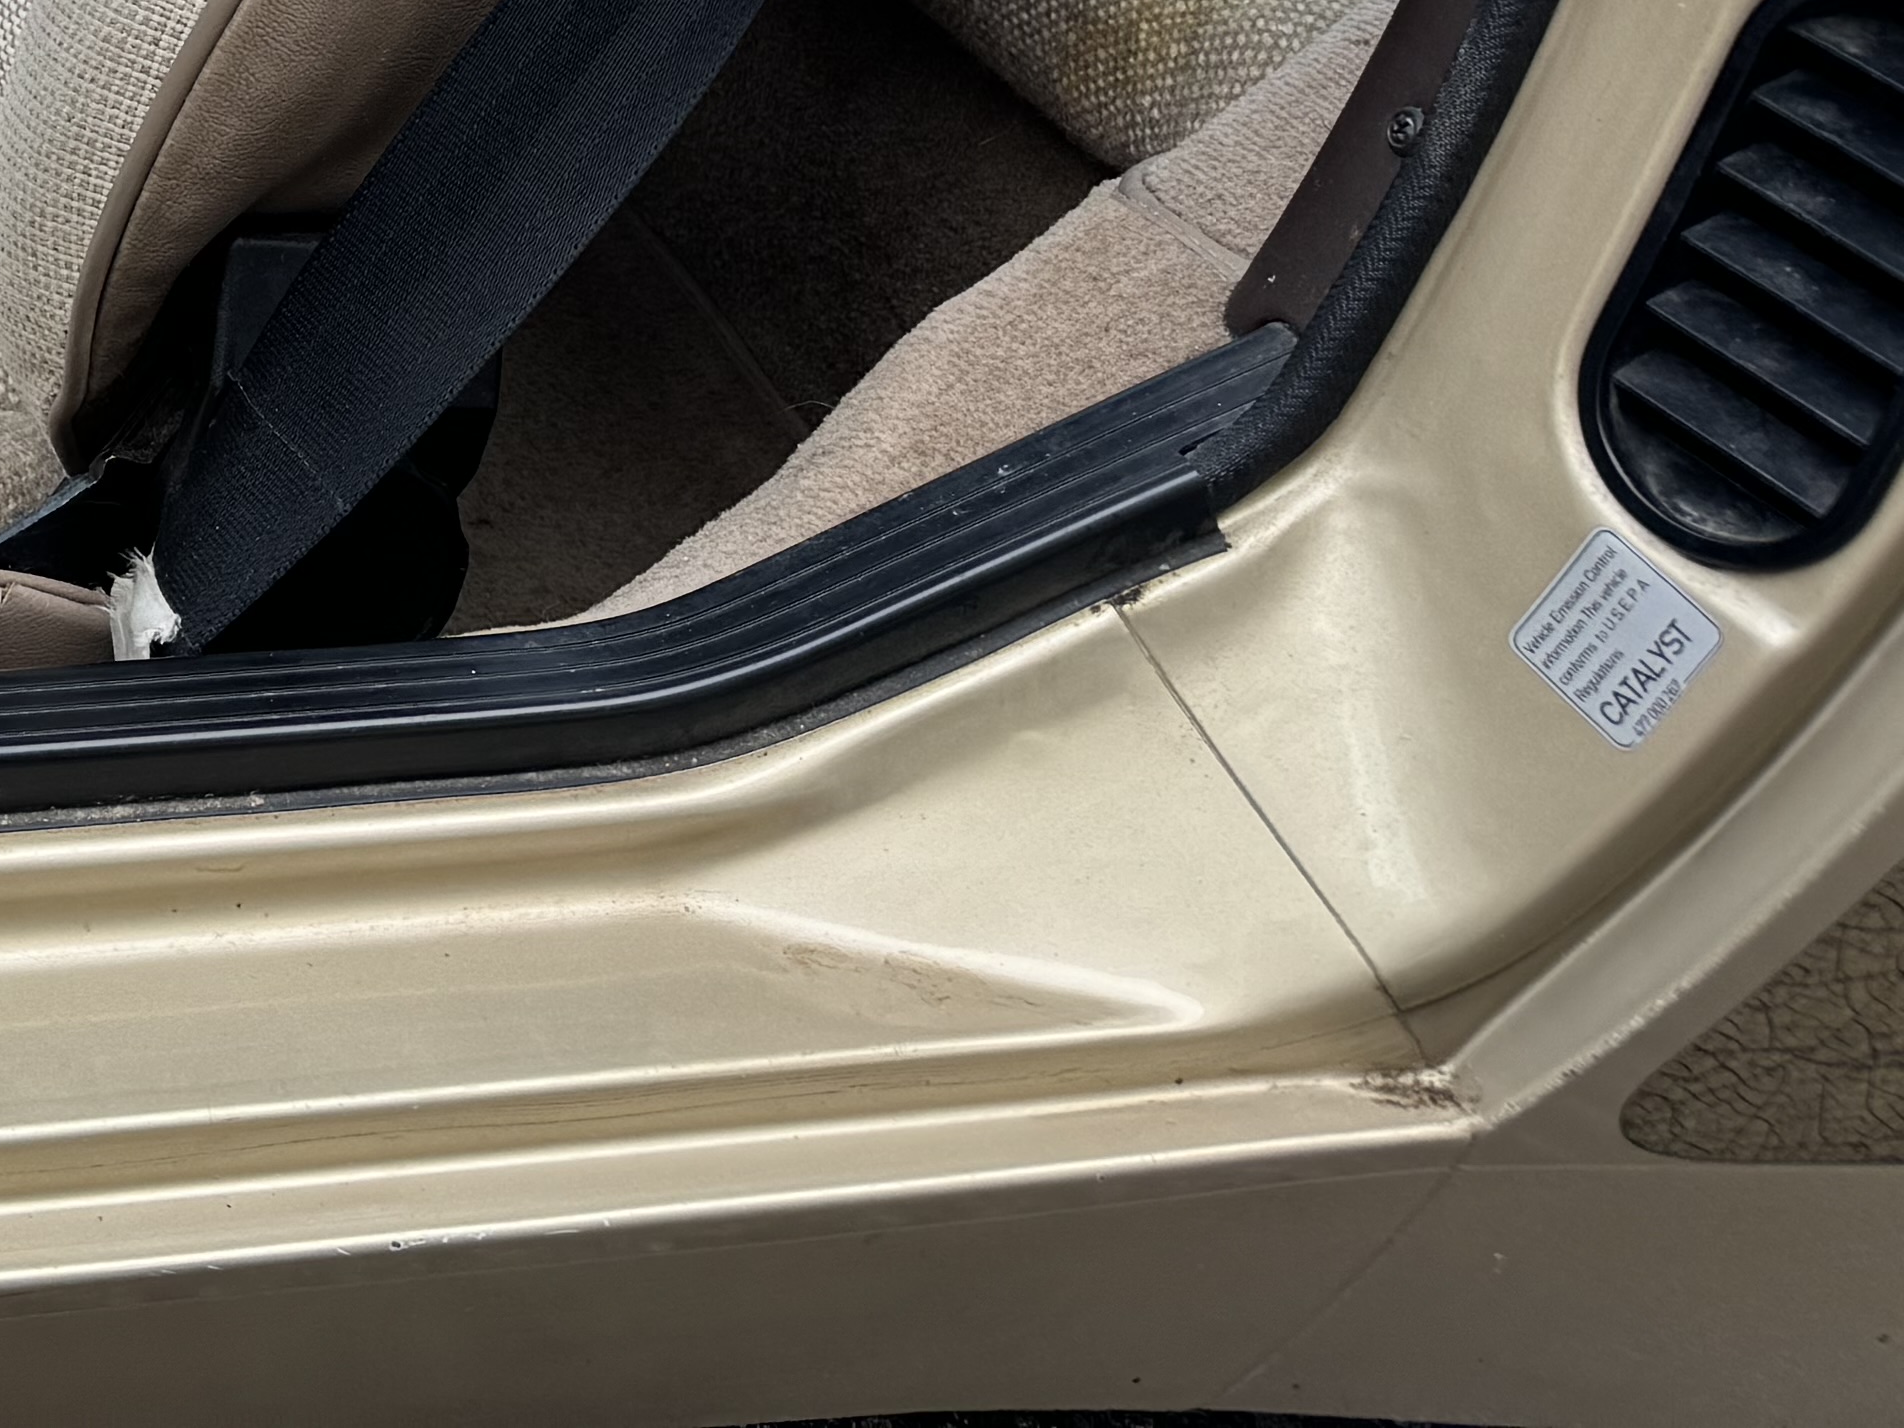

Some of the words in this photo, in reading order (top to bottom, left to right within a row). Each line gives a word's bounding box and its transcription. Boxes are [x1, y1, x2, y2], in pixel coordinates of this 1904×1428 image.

[1523, 622, 1555, 654] Vehicle
[1549, 581, 1590, 624] Emission
[1583, 545, 1617, 582] Control
[1580, 600, 1602, 619] This
[1599, 569, 1627, 601] vehicle
[1559, 643, 1598, 686] conforms
[1594, 630, 1608, 643] to
[1600, 619, 1692, 725] CATALYST
